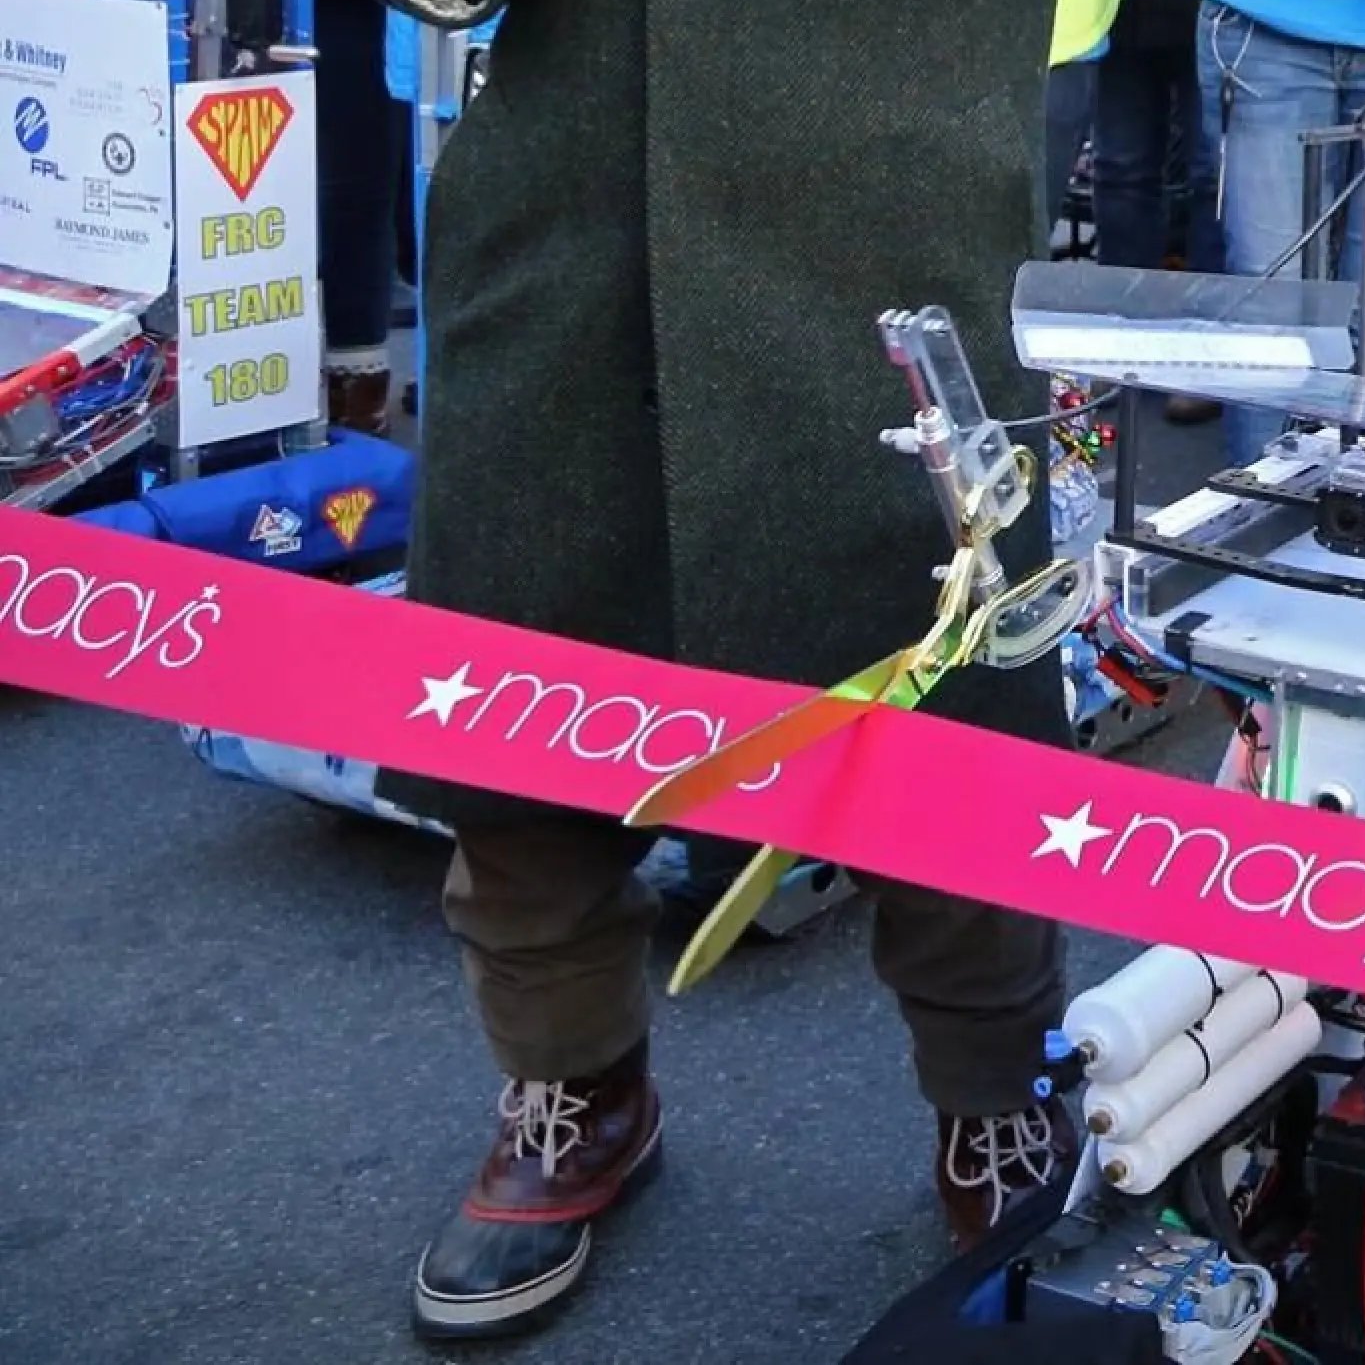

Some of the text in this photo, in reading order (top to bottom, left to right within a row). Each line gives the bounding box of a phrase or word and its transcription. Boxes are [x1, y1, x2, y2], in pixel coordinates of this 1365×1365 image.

[16, 40, 67, 74] Whitney
[31, 157, 68, 182] FPL
[200, 206, 287, 261] FRC
[184, 276, 304, 338] TEAM
[204, 353, 290, 408] 180
